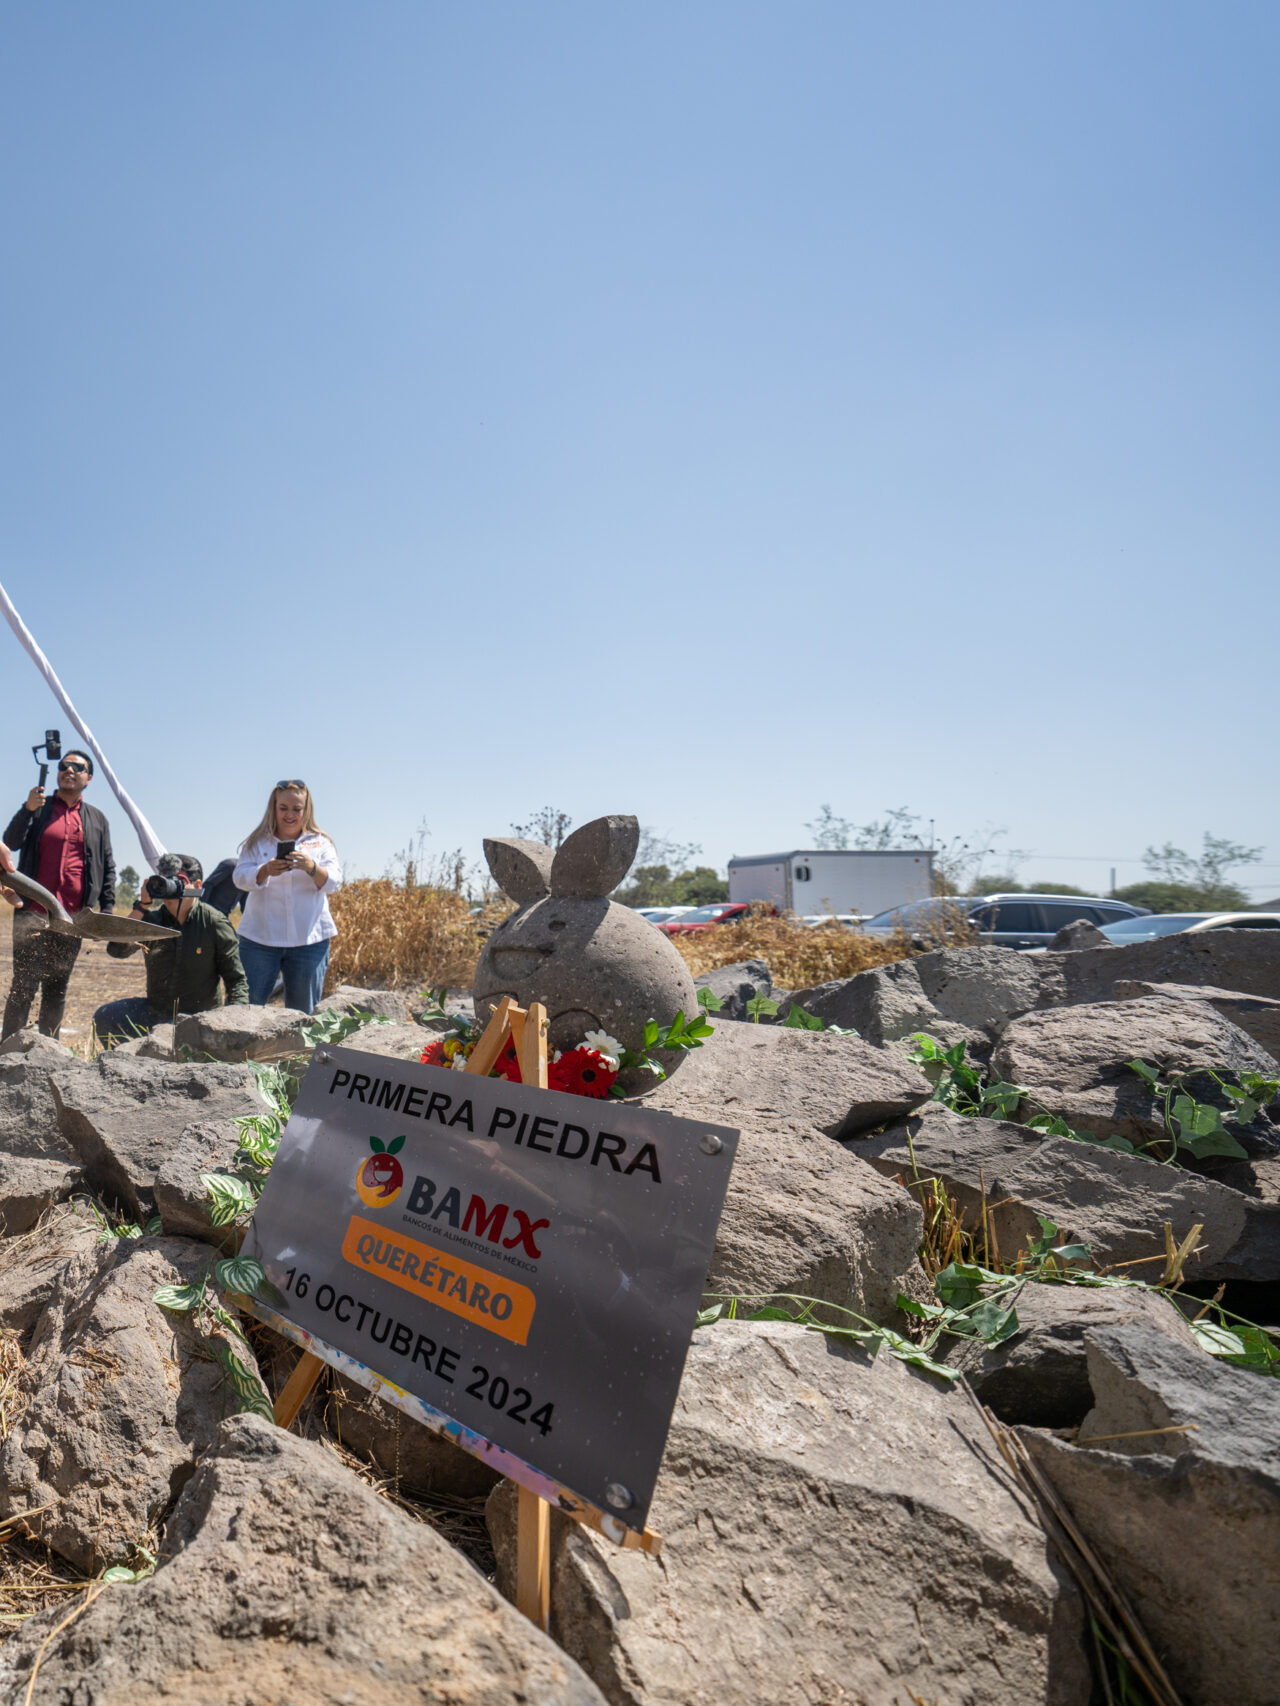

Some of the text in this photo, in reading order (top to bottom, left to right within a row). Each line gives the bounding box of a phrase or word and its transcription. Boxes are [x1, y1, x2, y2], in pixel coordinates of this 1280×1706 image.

[329, 1069, 663, 1184] PRIMERA PIEDRA
[402, 1214, 538, 1273] BANCOS DE ALIMENTOS DE MÉXICO
[406, 1175, 550, 1259] BAMX
[356, 1234, 514, 1321] QUERÉTARO
[285, 1267, 556, 1437] 16 OCTUBRE 2024
